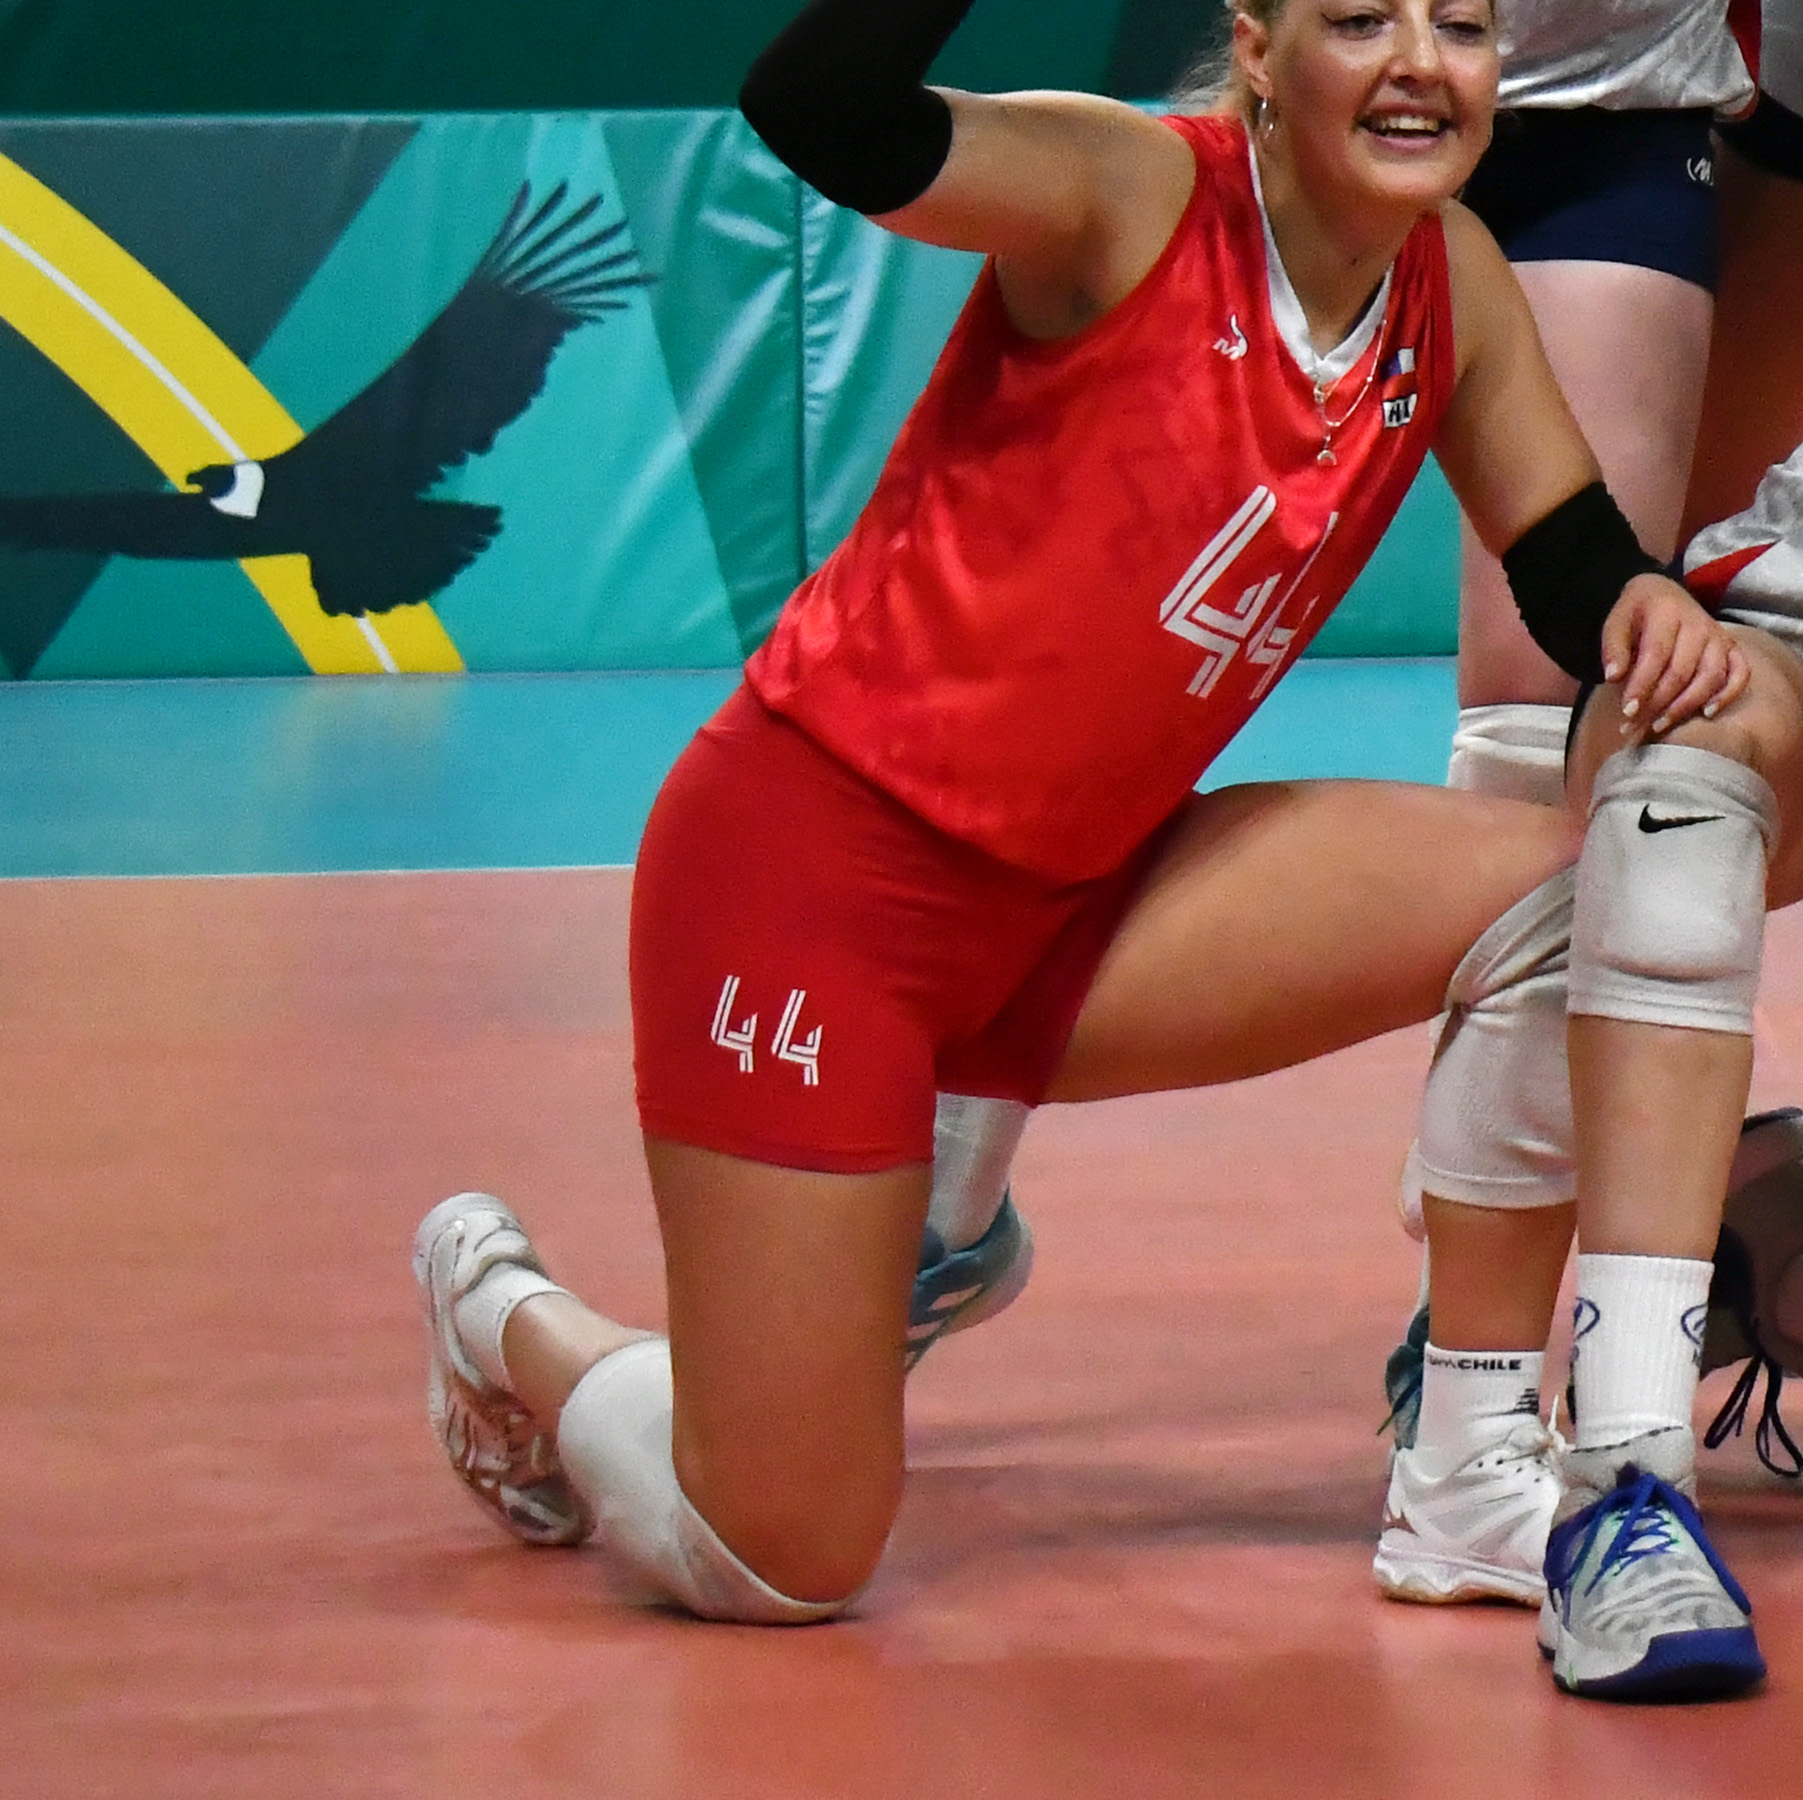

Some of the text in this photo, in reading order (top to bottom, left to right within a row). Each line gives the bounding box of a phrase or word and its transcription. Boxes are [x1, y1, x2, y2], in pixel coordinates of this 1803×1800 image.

[1159, 484, 1337, 699] 44
[711, 975, 823, 1086] 44
[1457, 1359, 1522, 1371] CHILE
